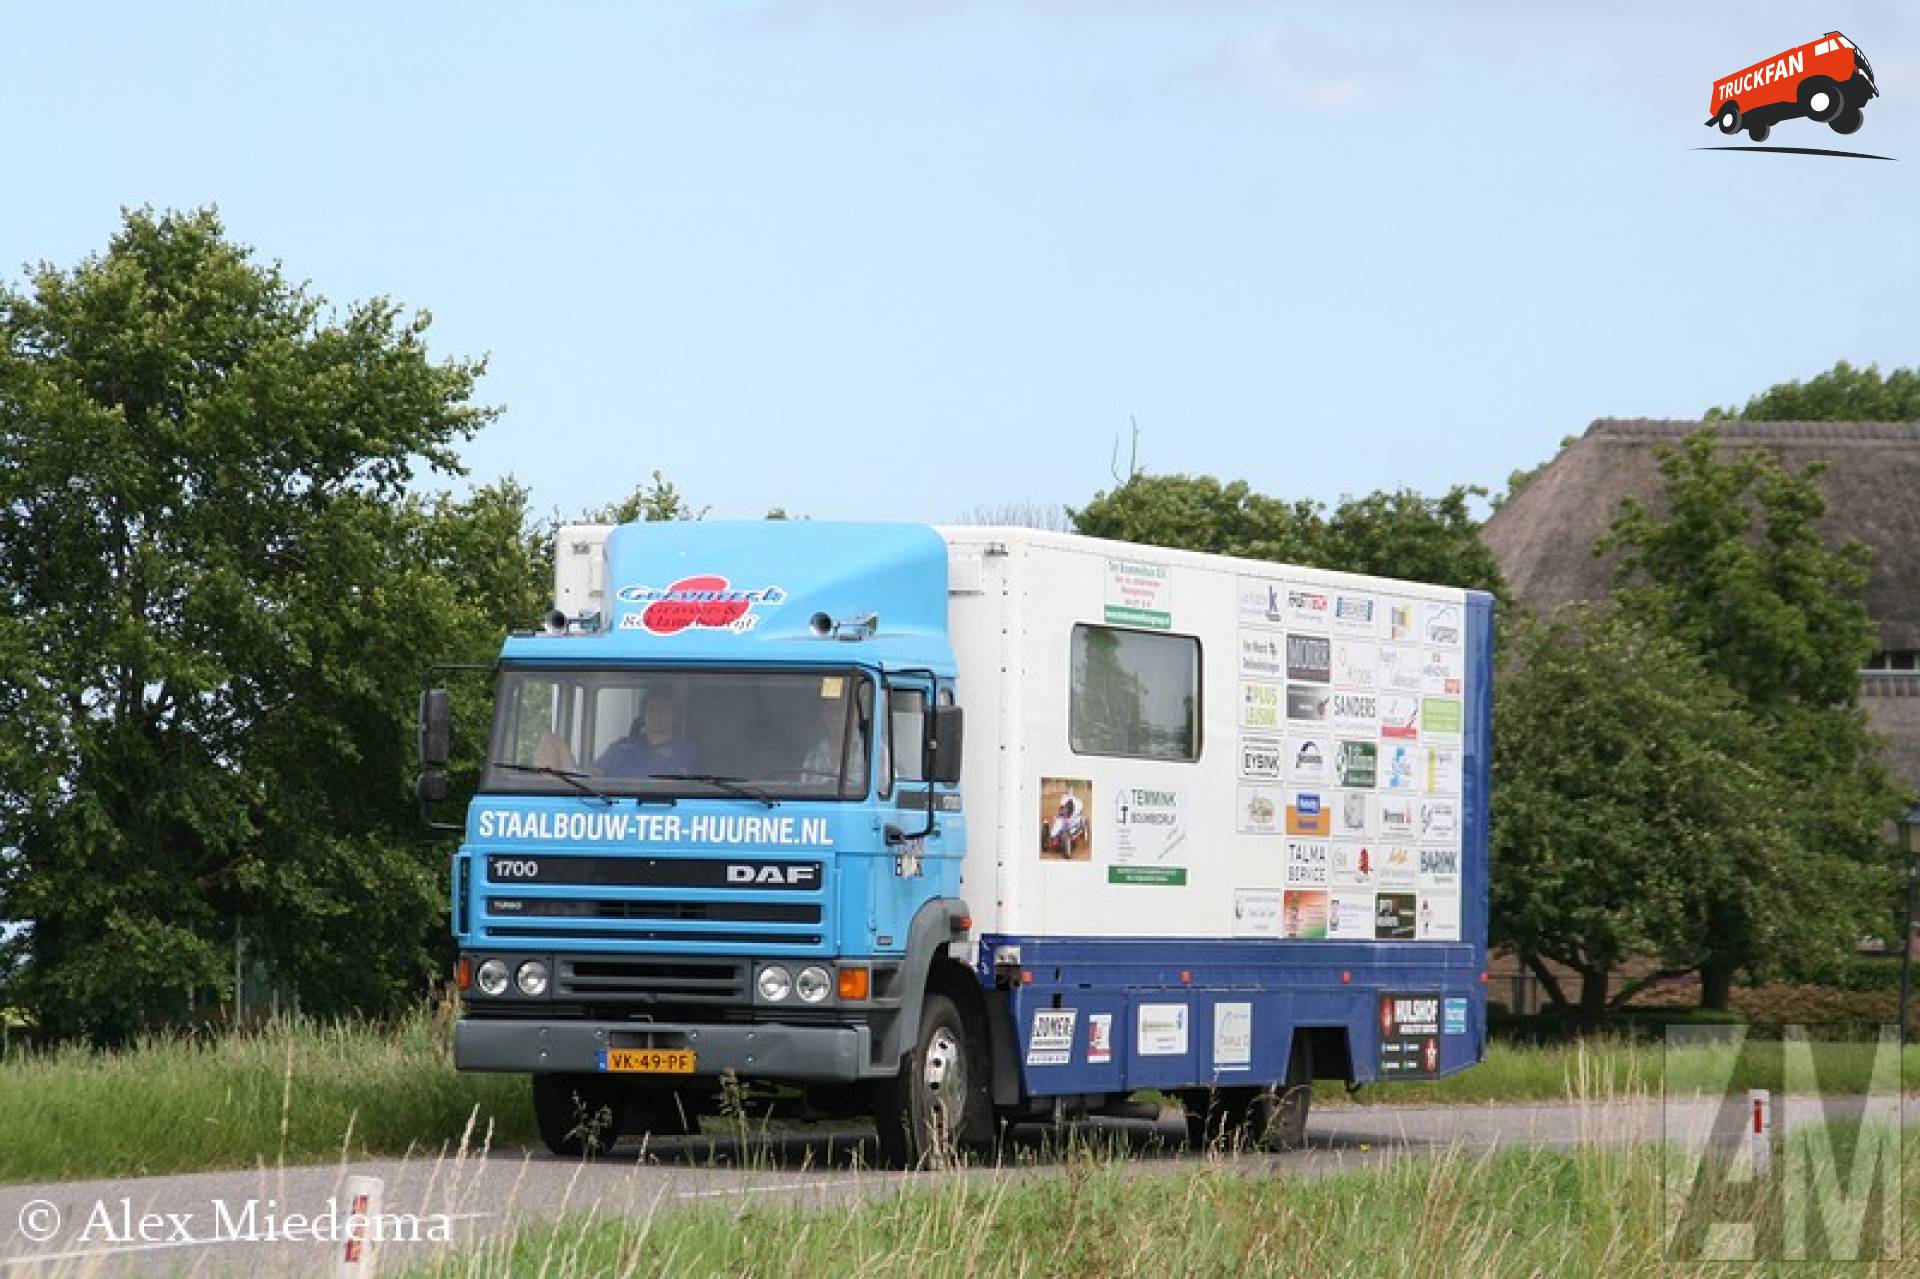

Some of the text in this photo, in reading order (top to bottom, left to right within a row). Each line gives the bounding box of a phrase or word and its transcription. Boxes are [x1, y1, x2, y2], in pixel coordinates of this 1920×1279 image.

[1334, 696, 1375, 718] SANDERS
[479, 810, 834, 846] STAALBOUW-TER-HUURNE.NL
[1288, 844, 1326, 862] TALMA
[494, 860, 538, 877] 1700
[726, 864, 816, 884] DAF
[1288, 866, 1326, 881] SERVICE
[611, 1054, 688, 1069] VK-49-PF
